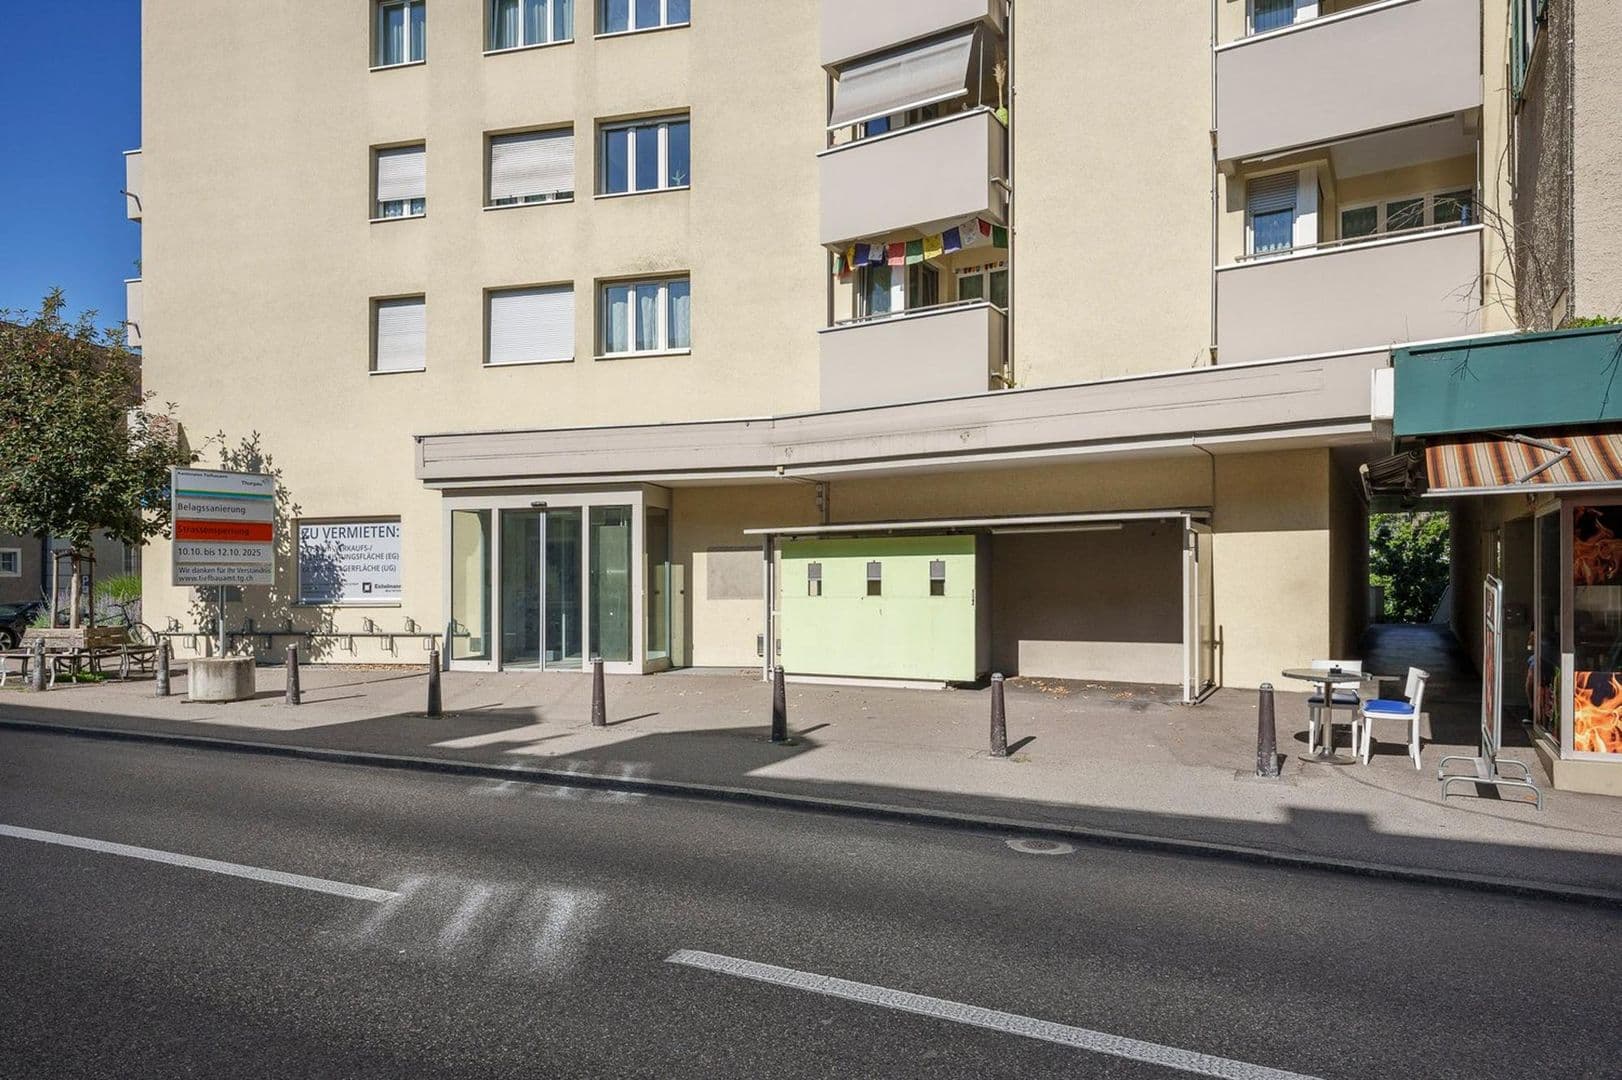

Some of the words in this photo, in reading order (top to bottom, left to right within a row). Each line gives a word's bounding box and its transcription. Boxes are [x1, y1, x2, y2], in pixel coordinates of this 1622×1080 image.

[177, 503, 246, 515] Belagssanierung
[178, 526, 249, 536] Strassensperrung
[301, 528, 319, 539] ZU
[322, 525, 400, 539] VERMIETEN:
[178, 547, 201, 557] 10.10.
[204, 547, 215, 557] bis
[218, 548, 240, 558] 12.10.
[243, 548, 262, 557] 2025
[385, 552, 400, 561] (EG)
[178, 566, 190, 574] Wir
[192, 566, 215, 574] danken
[216, 566, 226, 574] für
[237, 566, 272, 575] Verständnis
[381, 564, 397, 573] (UG)
